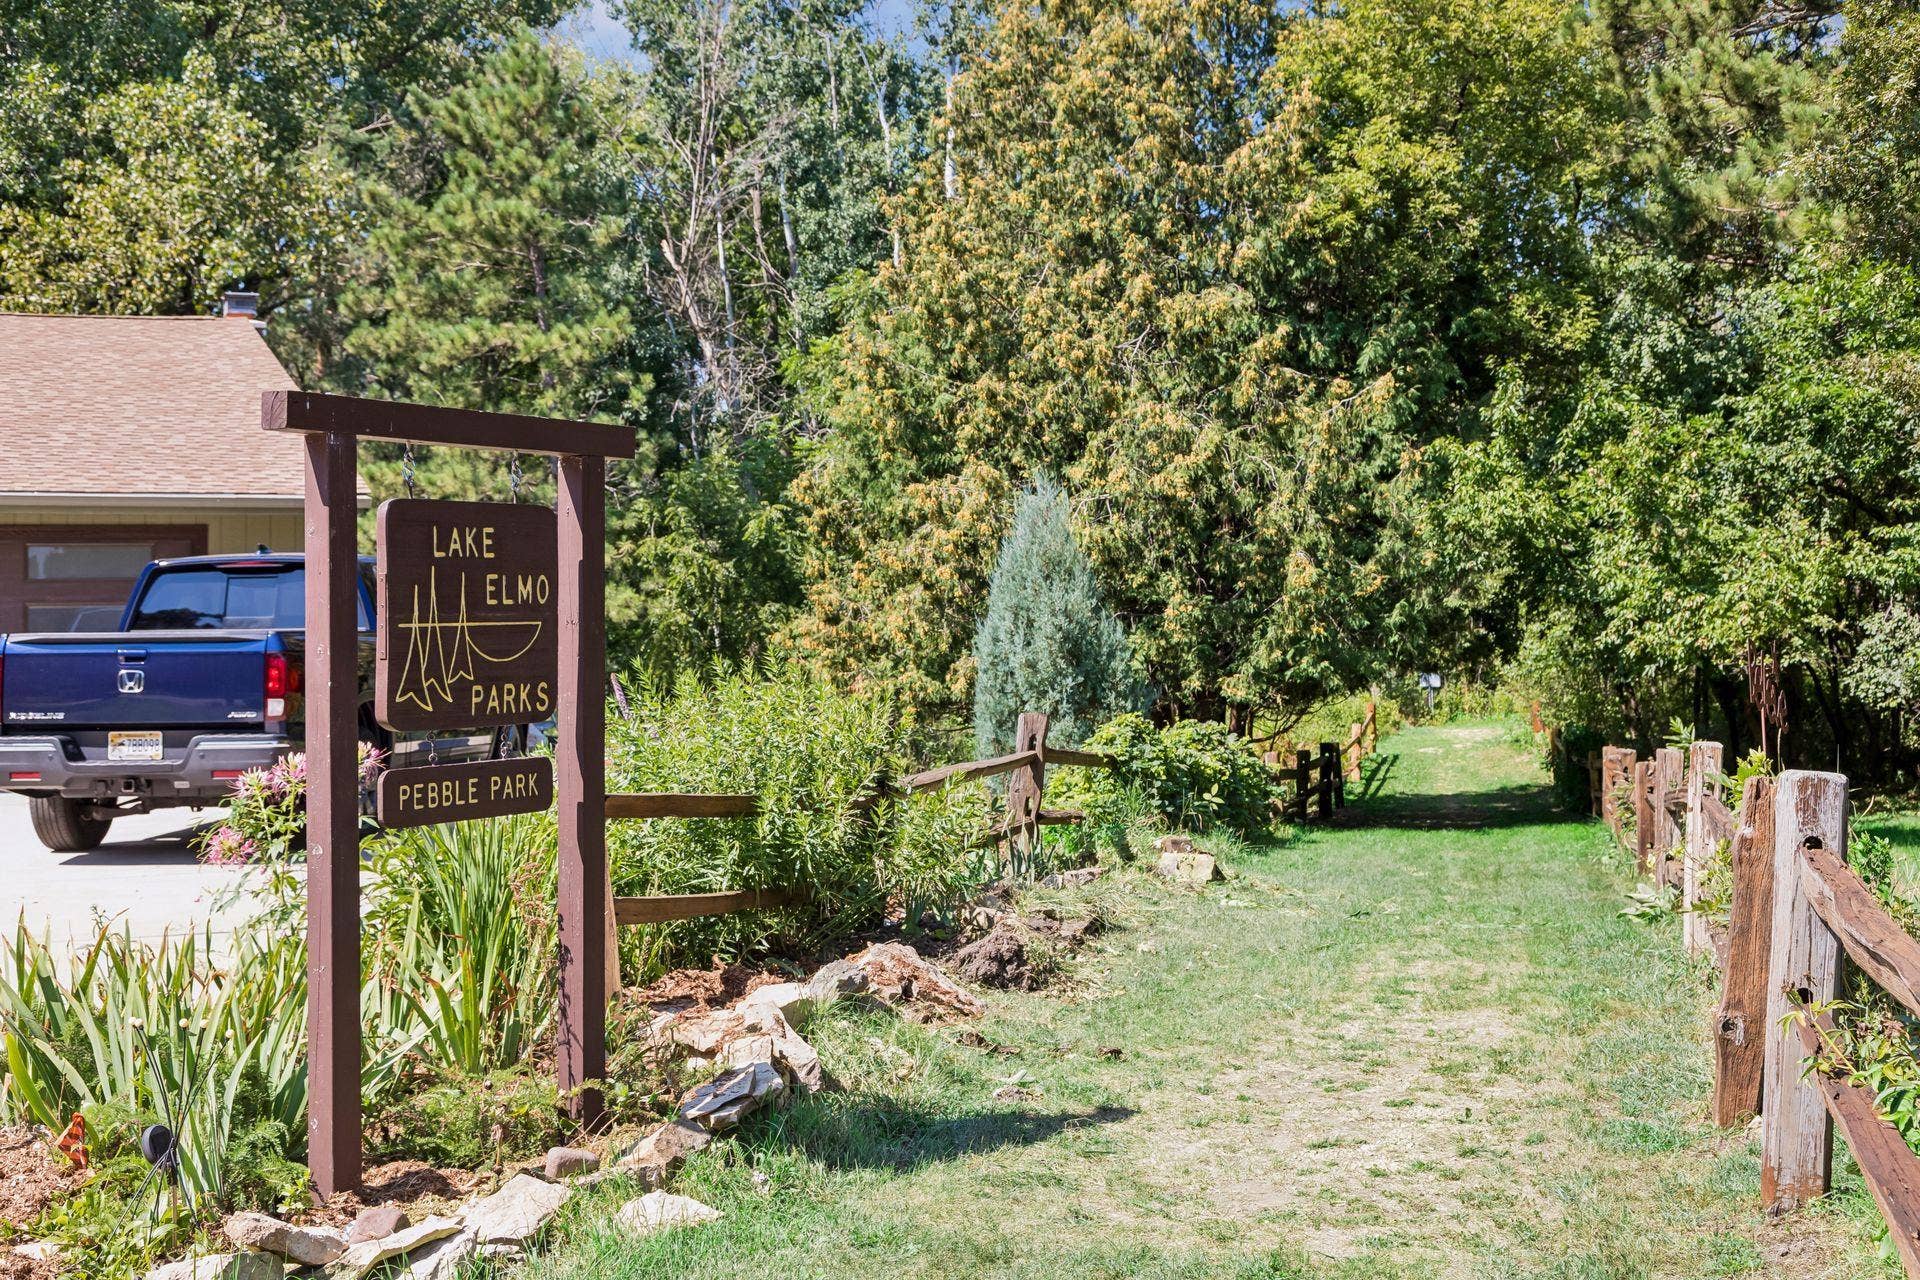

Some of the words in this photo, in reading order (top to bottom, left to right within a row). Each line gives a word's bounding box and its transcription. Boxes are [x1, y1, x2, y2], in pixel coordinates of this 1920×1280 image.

[433, 525, 495, 559] LAKE
[486, 573, 549, 605] ELMO
[471, 681, 550, 716] PARKS
[399, 777, 479, 811] PEBBLE
[490, 772, 539, 801] PARK
